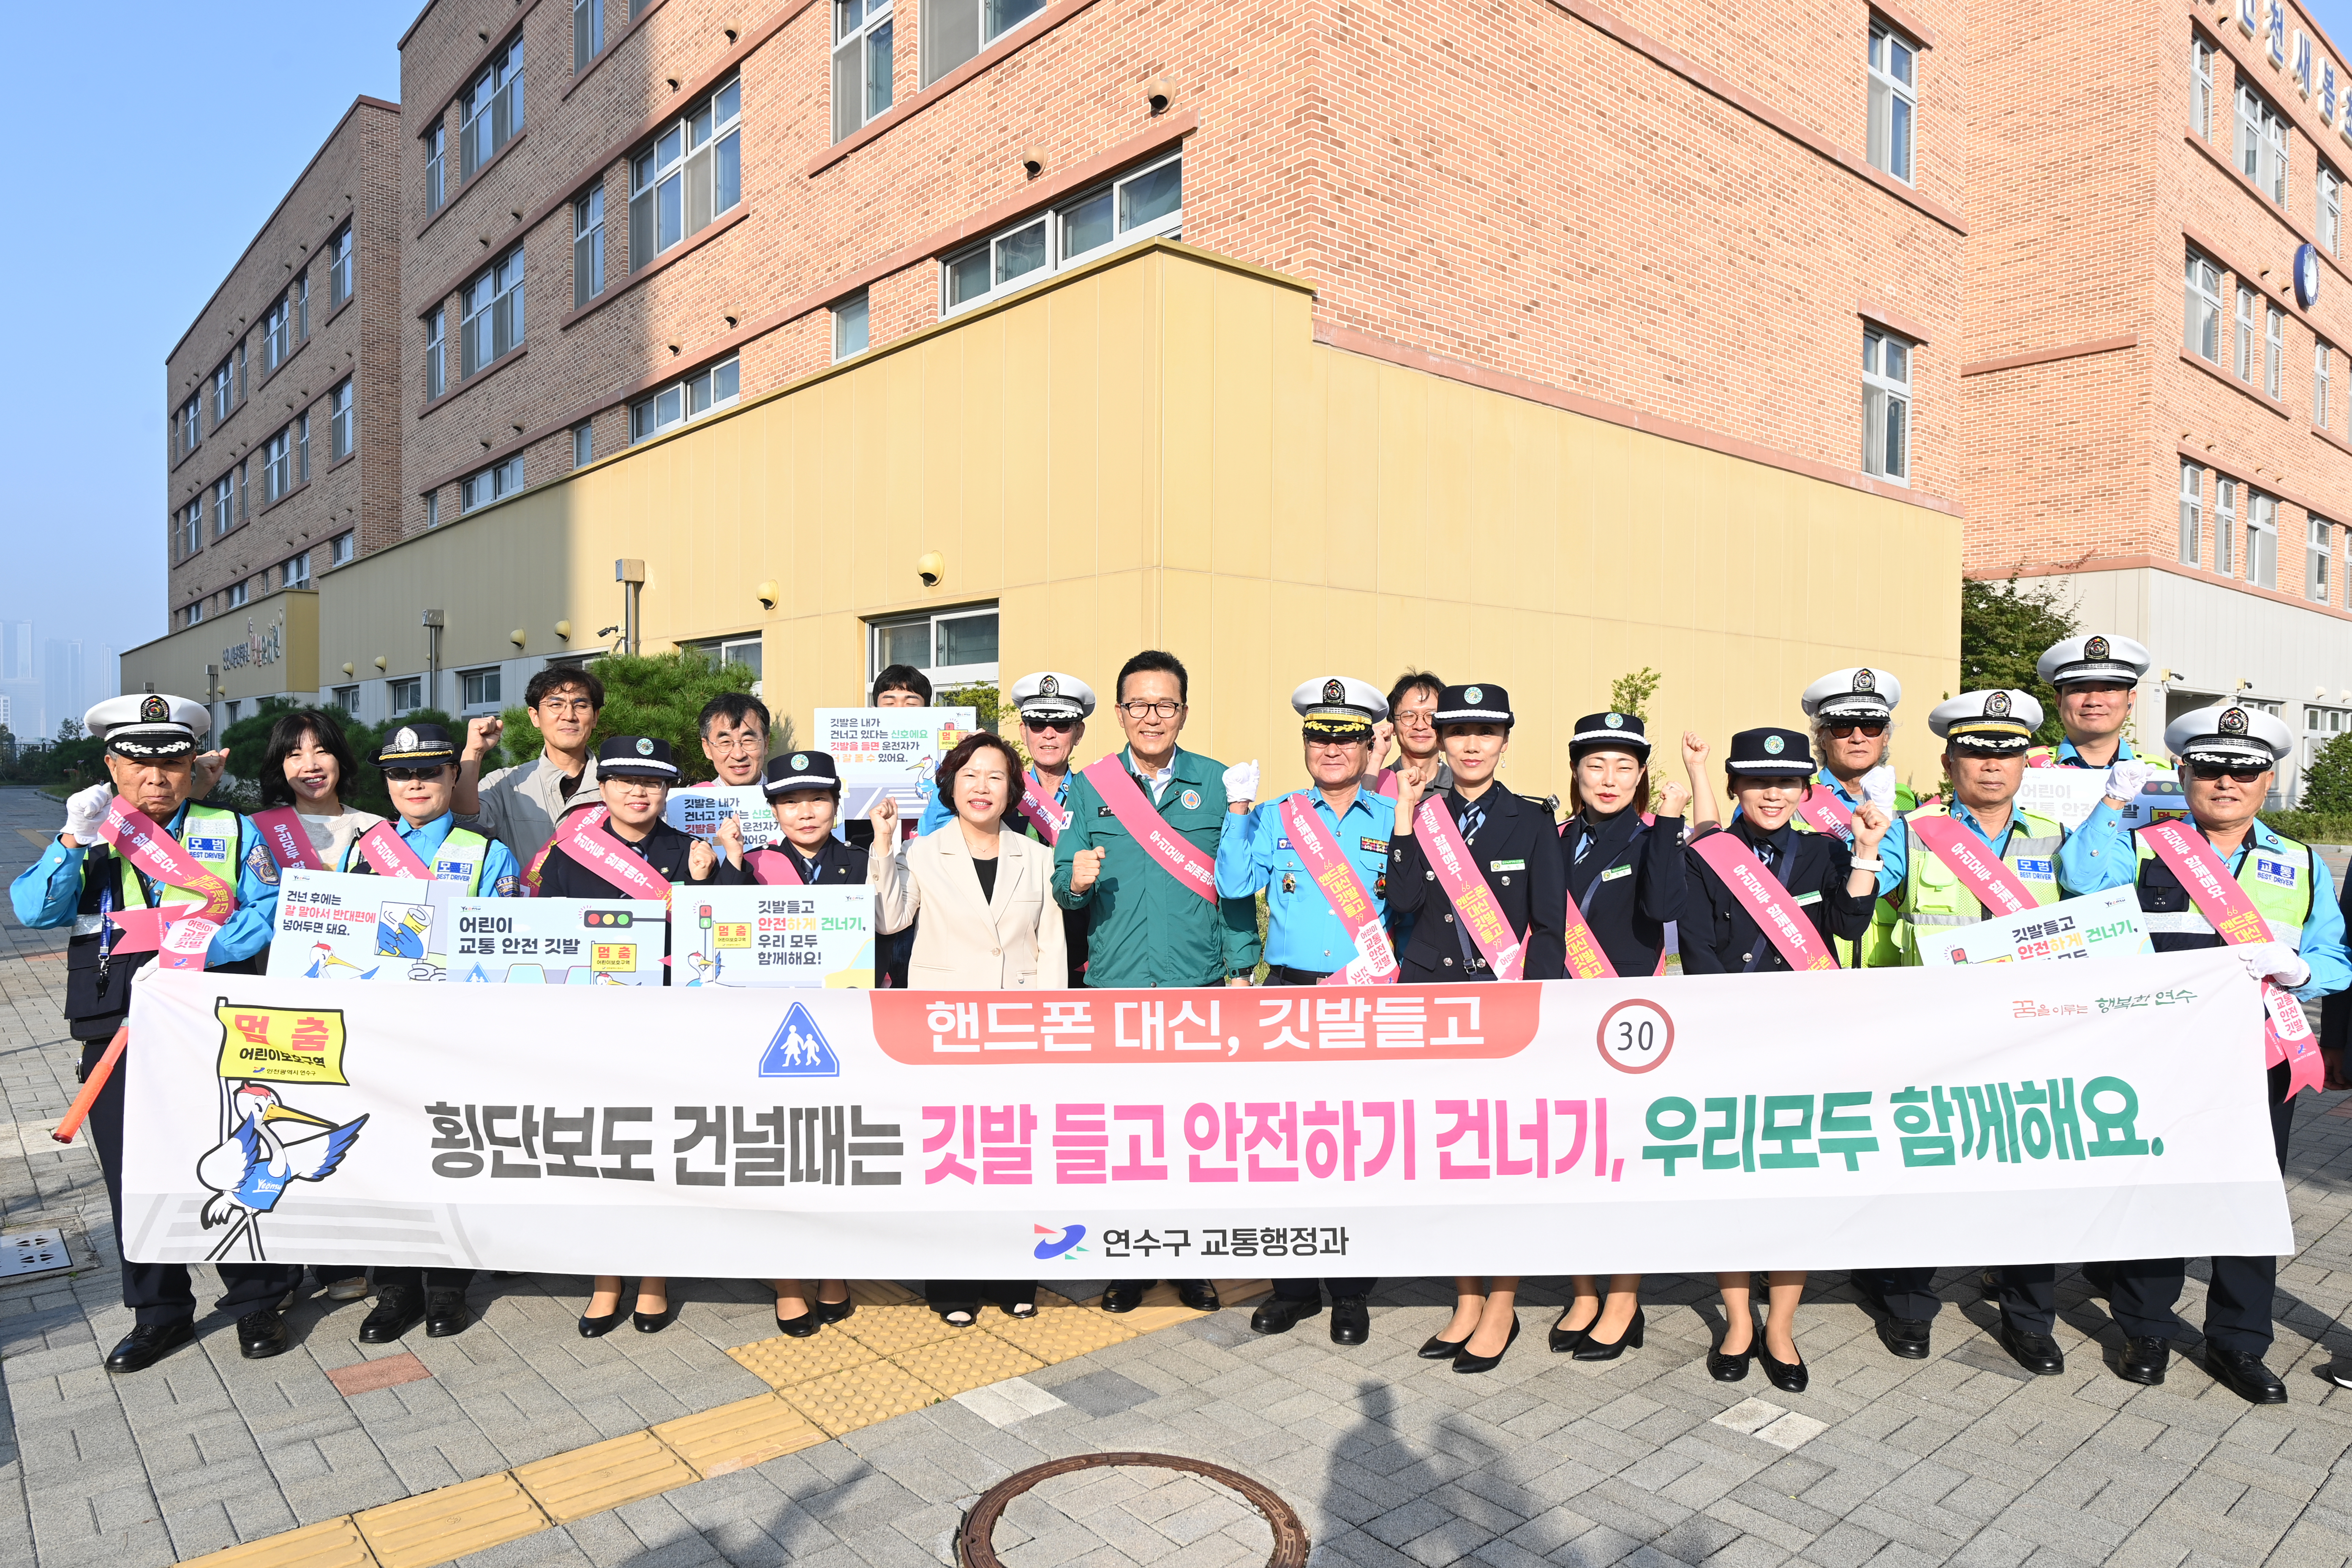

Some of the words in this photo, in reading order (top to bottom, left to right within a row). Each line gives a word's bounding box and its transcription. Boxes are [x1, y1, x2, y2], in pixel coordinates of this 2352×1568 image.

[830, 718, 858, 727] 깃발은
[861, 718, 880, 727] 내가
[830, 730, 858, 739] 건너고
[861, 730, 888, 739] 있다는
[891, 730, 928, 739] 신호에요
[830, 742, 858, 751] 깃발을
[861, 742, 879, 751] 들면
[882, 741, 920, 751] 운전자가
[843, 754, 851, 762] 잘
[855, 754, 864, 762] 볼
[866, 754, 876, 762] 수
[878, 753, 908, 762] 있어요.
[2021, 784, 2070, 799] 어린이
[684, 798, 716, 809] 깃발은
[719, 798, 740, 807] 내가
[684, 811, 716, 822] 건너고
[685, 823, 716, 834] 깃발을
[1293, 814, 1324, 860] 함께해요!
[273, 824, 300, 859] 우리모두
[1149, 830, 1185, 865] 우리모두
[1418, 802, 1441, 834] 우리모두
[1433, 833, 1462, 881] 함께해요!
[371, 835, 400, 869] 우리모두
[573, 833, 604, 858] 우리모두
[604, 852, 653, 889] 함께해요!
[1318, 862, 1349, 887] 핸드폰
[2156, 826, 2191, 855] 우리모두
[2183, 855, 2227, 905] 함께해요!
[1329, 875, 1352, 894] 대신
[1951, 842, 1992, 882] 우리모두
[1988, 879, 2026, 914] 함께해
[2257, 872, 2273, 881] BEST
[2274, 876, 2293, 887] DRIVER
[210, 889, 229, 903] 깃발
[287, 890, 308, 903] 건넌
[310, 892, 341, 906] 후에는
[1336, 886, 1360, 906] 깃발
[1455, 884, 1488, 910] 핸드폰
[285, 905, 296, 916] 잘
[299, 906, 330, 920] 말아서
[333, 909, 376, 924] 반대편에
[758, 900, 814, 914] 깃발들고
[1343, 898, 1366, 918] 들고
[1466, 901, 1490, 919] 대신
[1733, 864, 1771, 904] 우리모두
[1766, 903, 1808, 954] 함께해요!
[188, 920, 213, 932] 어린이
[283, 919, 323, 934] 넣어두면
[326, 923, 350, 936] 돼요.
[460, 917, 512, 934] 어린이
[758, 917, 817, 931] 안전하게
[821, 917, 866, 931] 건너기,
[1473, 909, 1498, 931] 깃발
[2219, 911, 2259, 934] 핸드폰
[1360, 924, 1377, 939] 어린이
[1480, 923, 1504, 944] 들고
[2012, 916, 2076, 943] 깃발들고
[2234, 925, 2262, 943] 대신
[459, 938, 495, 954] 교통
[502, 938, 538, 954] 안전
[544, 938, 580, 955] 깃발
[758, 934, 785, 948] 우리
[790, 934, 818, 948] 모두
[1364, 932, 1382, 950] 교통
[1566, 937, 1589, 956] 대신
[2018, 932, 2083, 960] 안전하게
[2085, 920, 2138, 943] 건너기,
[758, 952, 821, 965] 함께해요!
[1369, 943, 1386, 961] 안전
[1500, 949, 1518, 966] 어린이
[1572, 948, 1597, 969] 깃발
[1374, 954, 1391, 972] 깃발
[1579, 961, 1605, 979] 들고
[2095, 994, 2151, 1013] 행복한
[2155, 989, 2198, 1005] 연수
[2274, 993, 2294, 1010] 교통
[2280, 1005, 2299, 1023] 안전
[927, 1000, 1095, 1053] 핸드폰
[1115, 999, 1239, 1057] 대신,
[1259, 997, 1484, 1052] 깃발들고
[1618, 1021, 1654, 1051] 30
[2285, 1018, 2304, 1036] 깃발
[240, 1048, 326, 1068] 어린이보호구역
[425, 1101, 655, 1182] 횡단보도
[674, 1105, 904, 1186] 건널때는
[921, 1104, 1037, 1184] 깃발
[1052, 1103, 1168, 1184] 들고
[1184, 1100, 1416, 1182] 안전하기
[1435, 1098, 1625, 1182] 건너기,
[1642, 1091, 1880, 1176] 우리모두
[1890, 1076, 2164, 1167] 함께해요.
[1102, 1228, 1191, 1258] 연수구
[1200, 1226, 1349, 1257] 교통행정과
